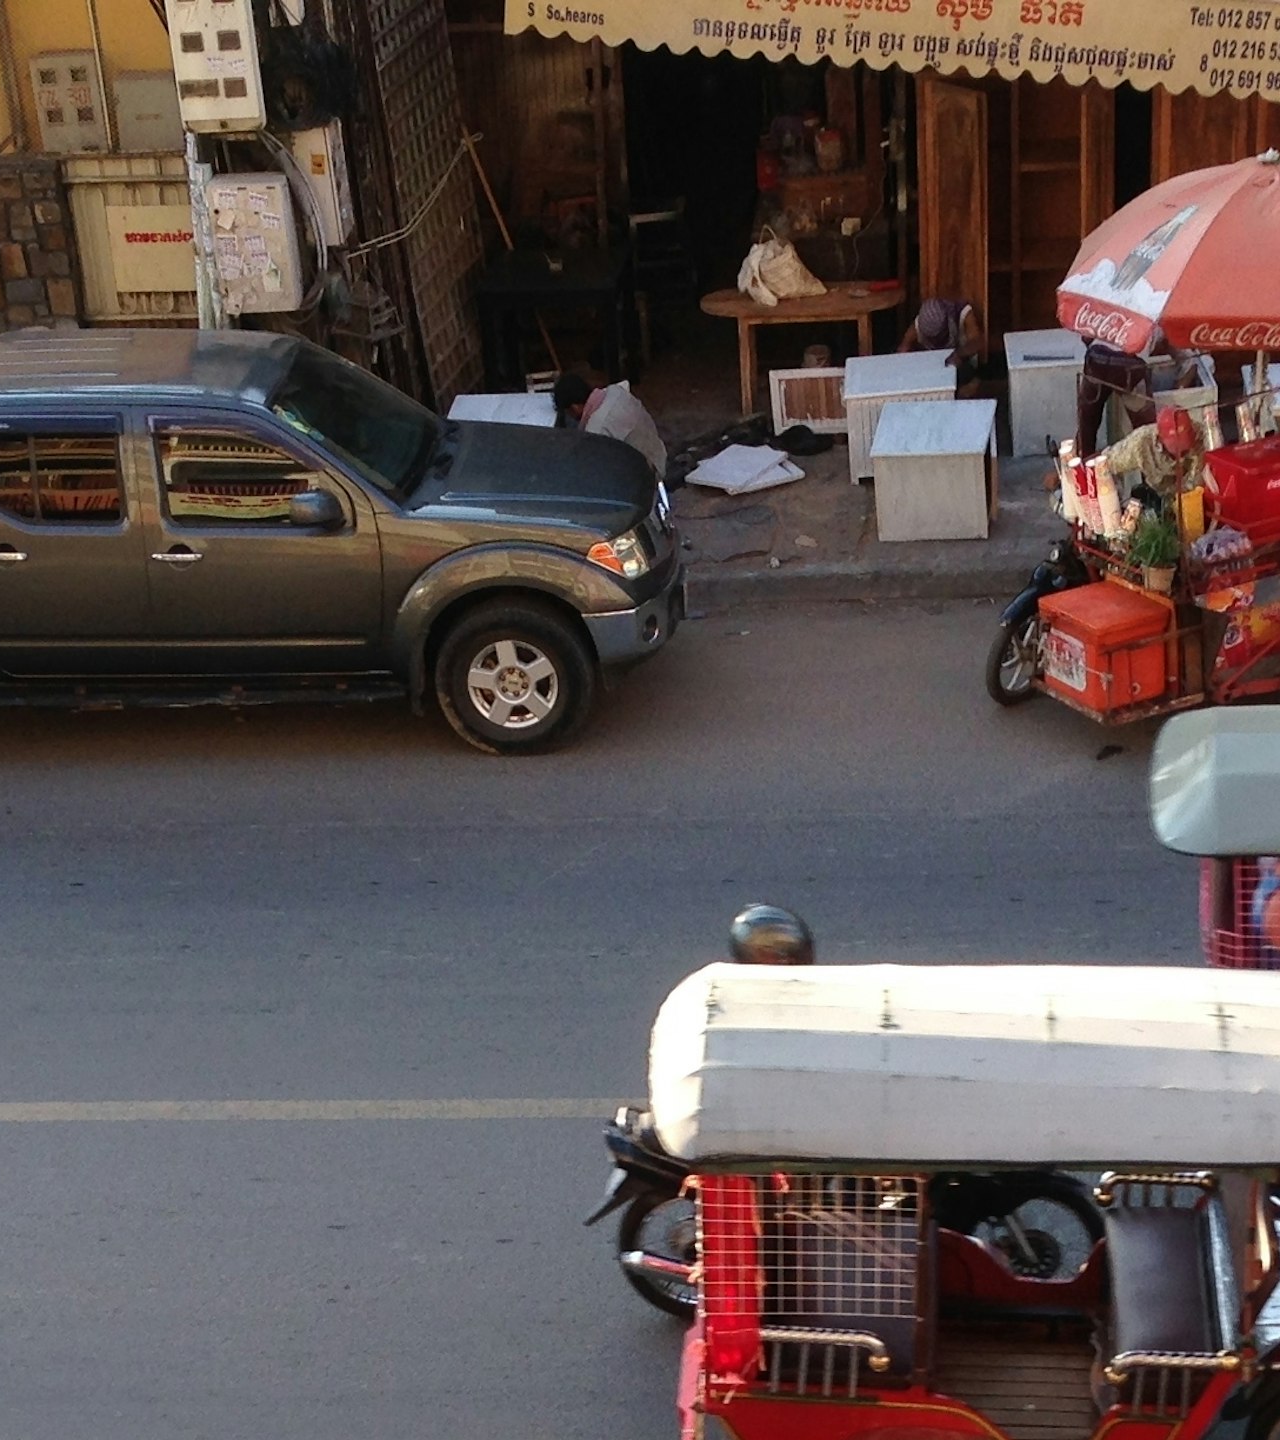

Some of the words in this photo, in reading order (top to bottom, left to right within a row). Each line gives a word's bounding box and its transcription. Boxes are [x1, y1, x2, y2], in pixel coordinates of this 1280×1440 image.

[546, 4, 605, 26] Sohearos
[1190, 8, 1214, 27] Tel:
[1218, 9, 1243, 28] 012
[1246, 10, 1271, 31] 857
[1213, 40, 1237, 59] 012
[1240, 40, 1266, 60] 216
[1210, 69, 1235, 87] 012
[1238, 70, 1262, 89] 691
